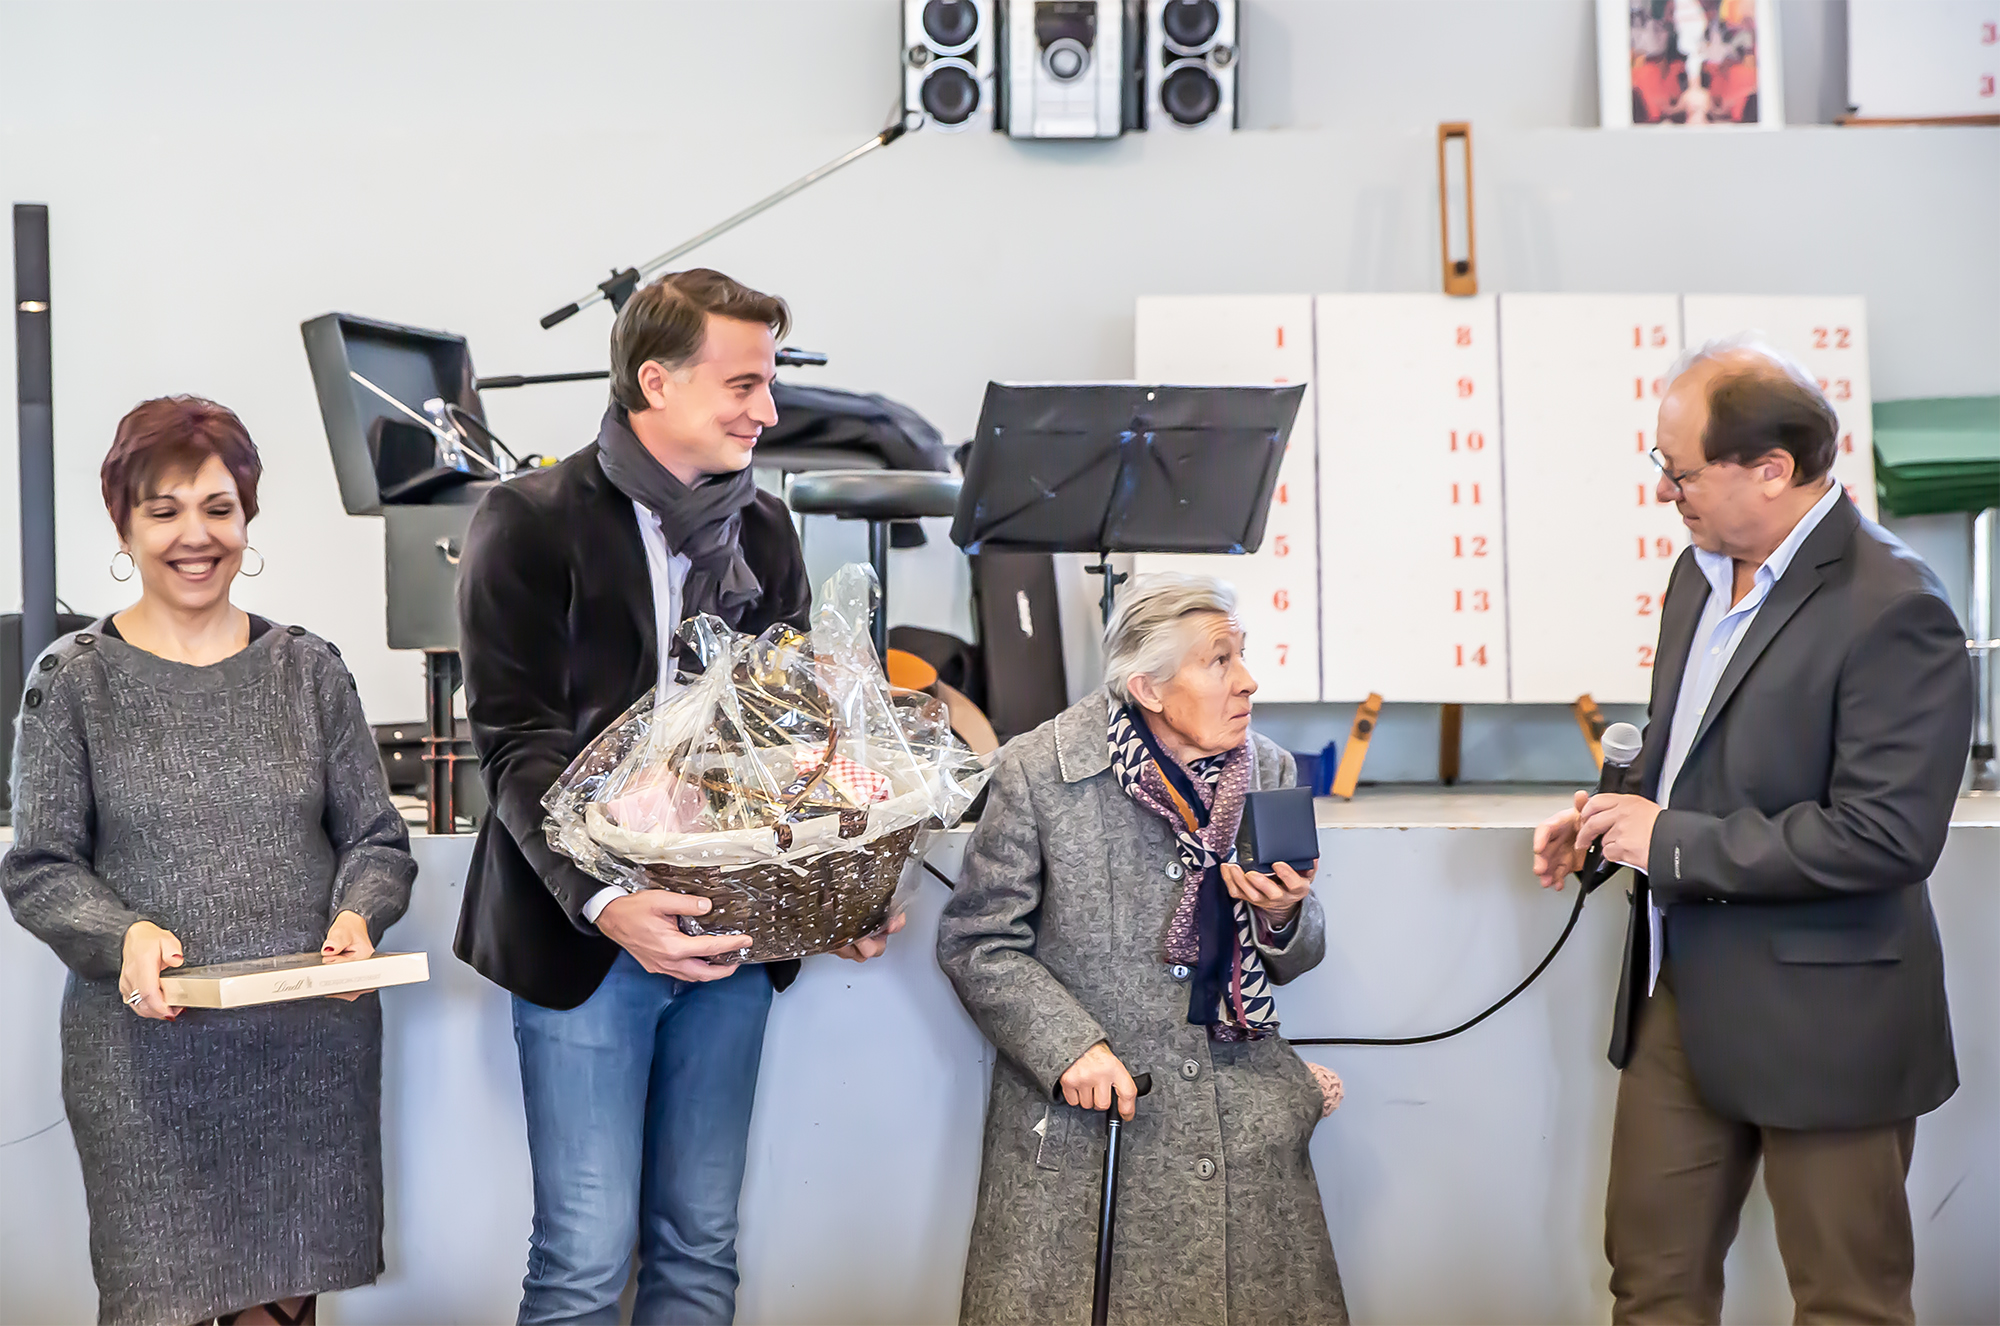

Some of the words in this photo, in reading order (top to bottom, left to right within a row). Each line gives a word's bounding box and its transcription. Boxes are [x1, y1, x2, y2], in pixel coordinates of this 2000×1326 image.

[1275, 326, 1286, 349] 1
[1454, 325, 1474, 348] 8
[1632, 325, 1668, 349] 15
[1812, 326, 1851, 350] 22
[1455, 376, 1475, 400] 9
[1448, 430, 1486, 453] 10
[1635, 429, 1647, 455] 1
[1270, 482, 1289, 506] 4
[1450, 481, 1483, 507] 11
[1273, 533, 1290, 558] 5
[1452, 534, 1489, 559] 12
[1635, 535, 1675, 560] 19
[1271, 588, 1291, 612] 6
[1453, 589, 1492, 613] 13
[1635, 588, 1667, 617] 2
[1275, 643, 1290, 667] 7
[1454, 643, 1489, 668] 14
[1636, 644, 1655, 669] 2
